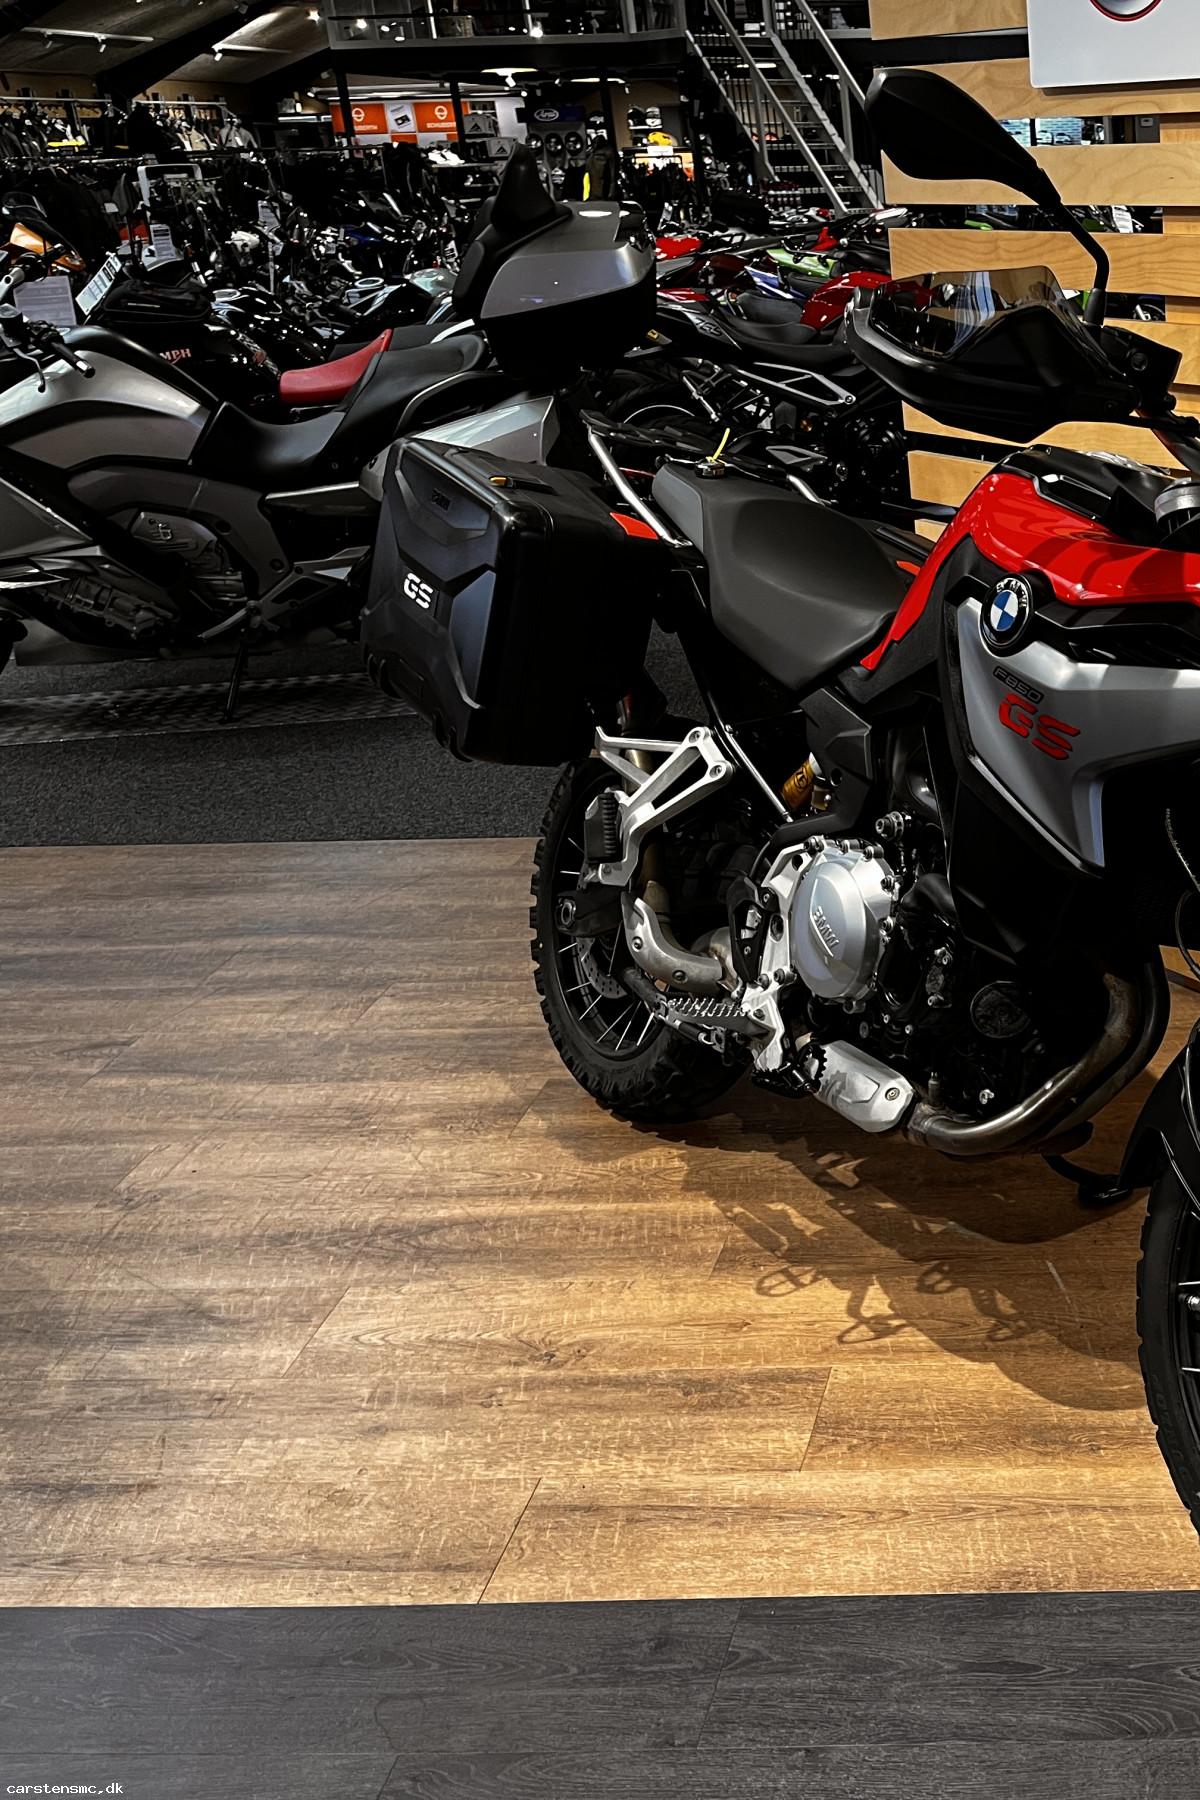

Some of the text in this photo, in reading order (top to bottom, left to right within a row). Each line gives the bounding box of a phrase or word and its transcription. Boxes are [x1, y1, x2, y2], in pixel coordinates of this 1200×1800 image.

[403, 572, 434, 609] GS
[994, 668, 1043, 703] F850
[998, 692, 1081, 761] GS
[813, 906, 840, 949] BMW
